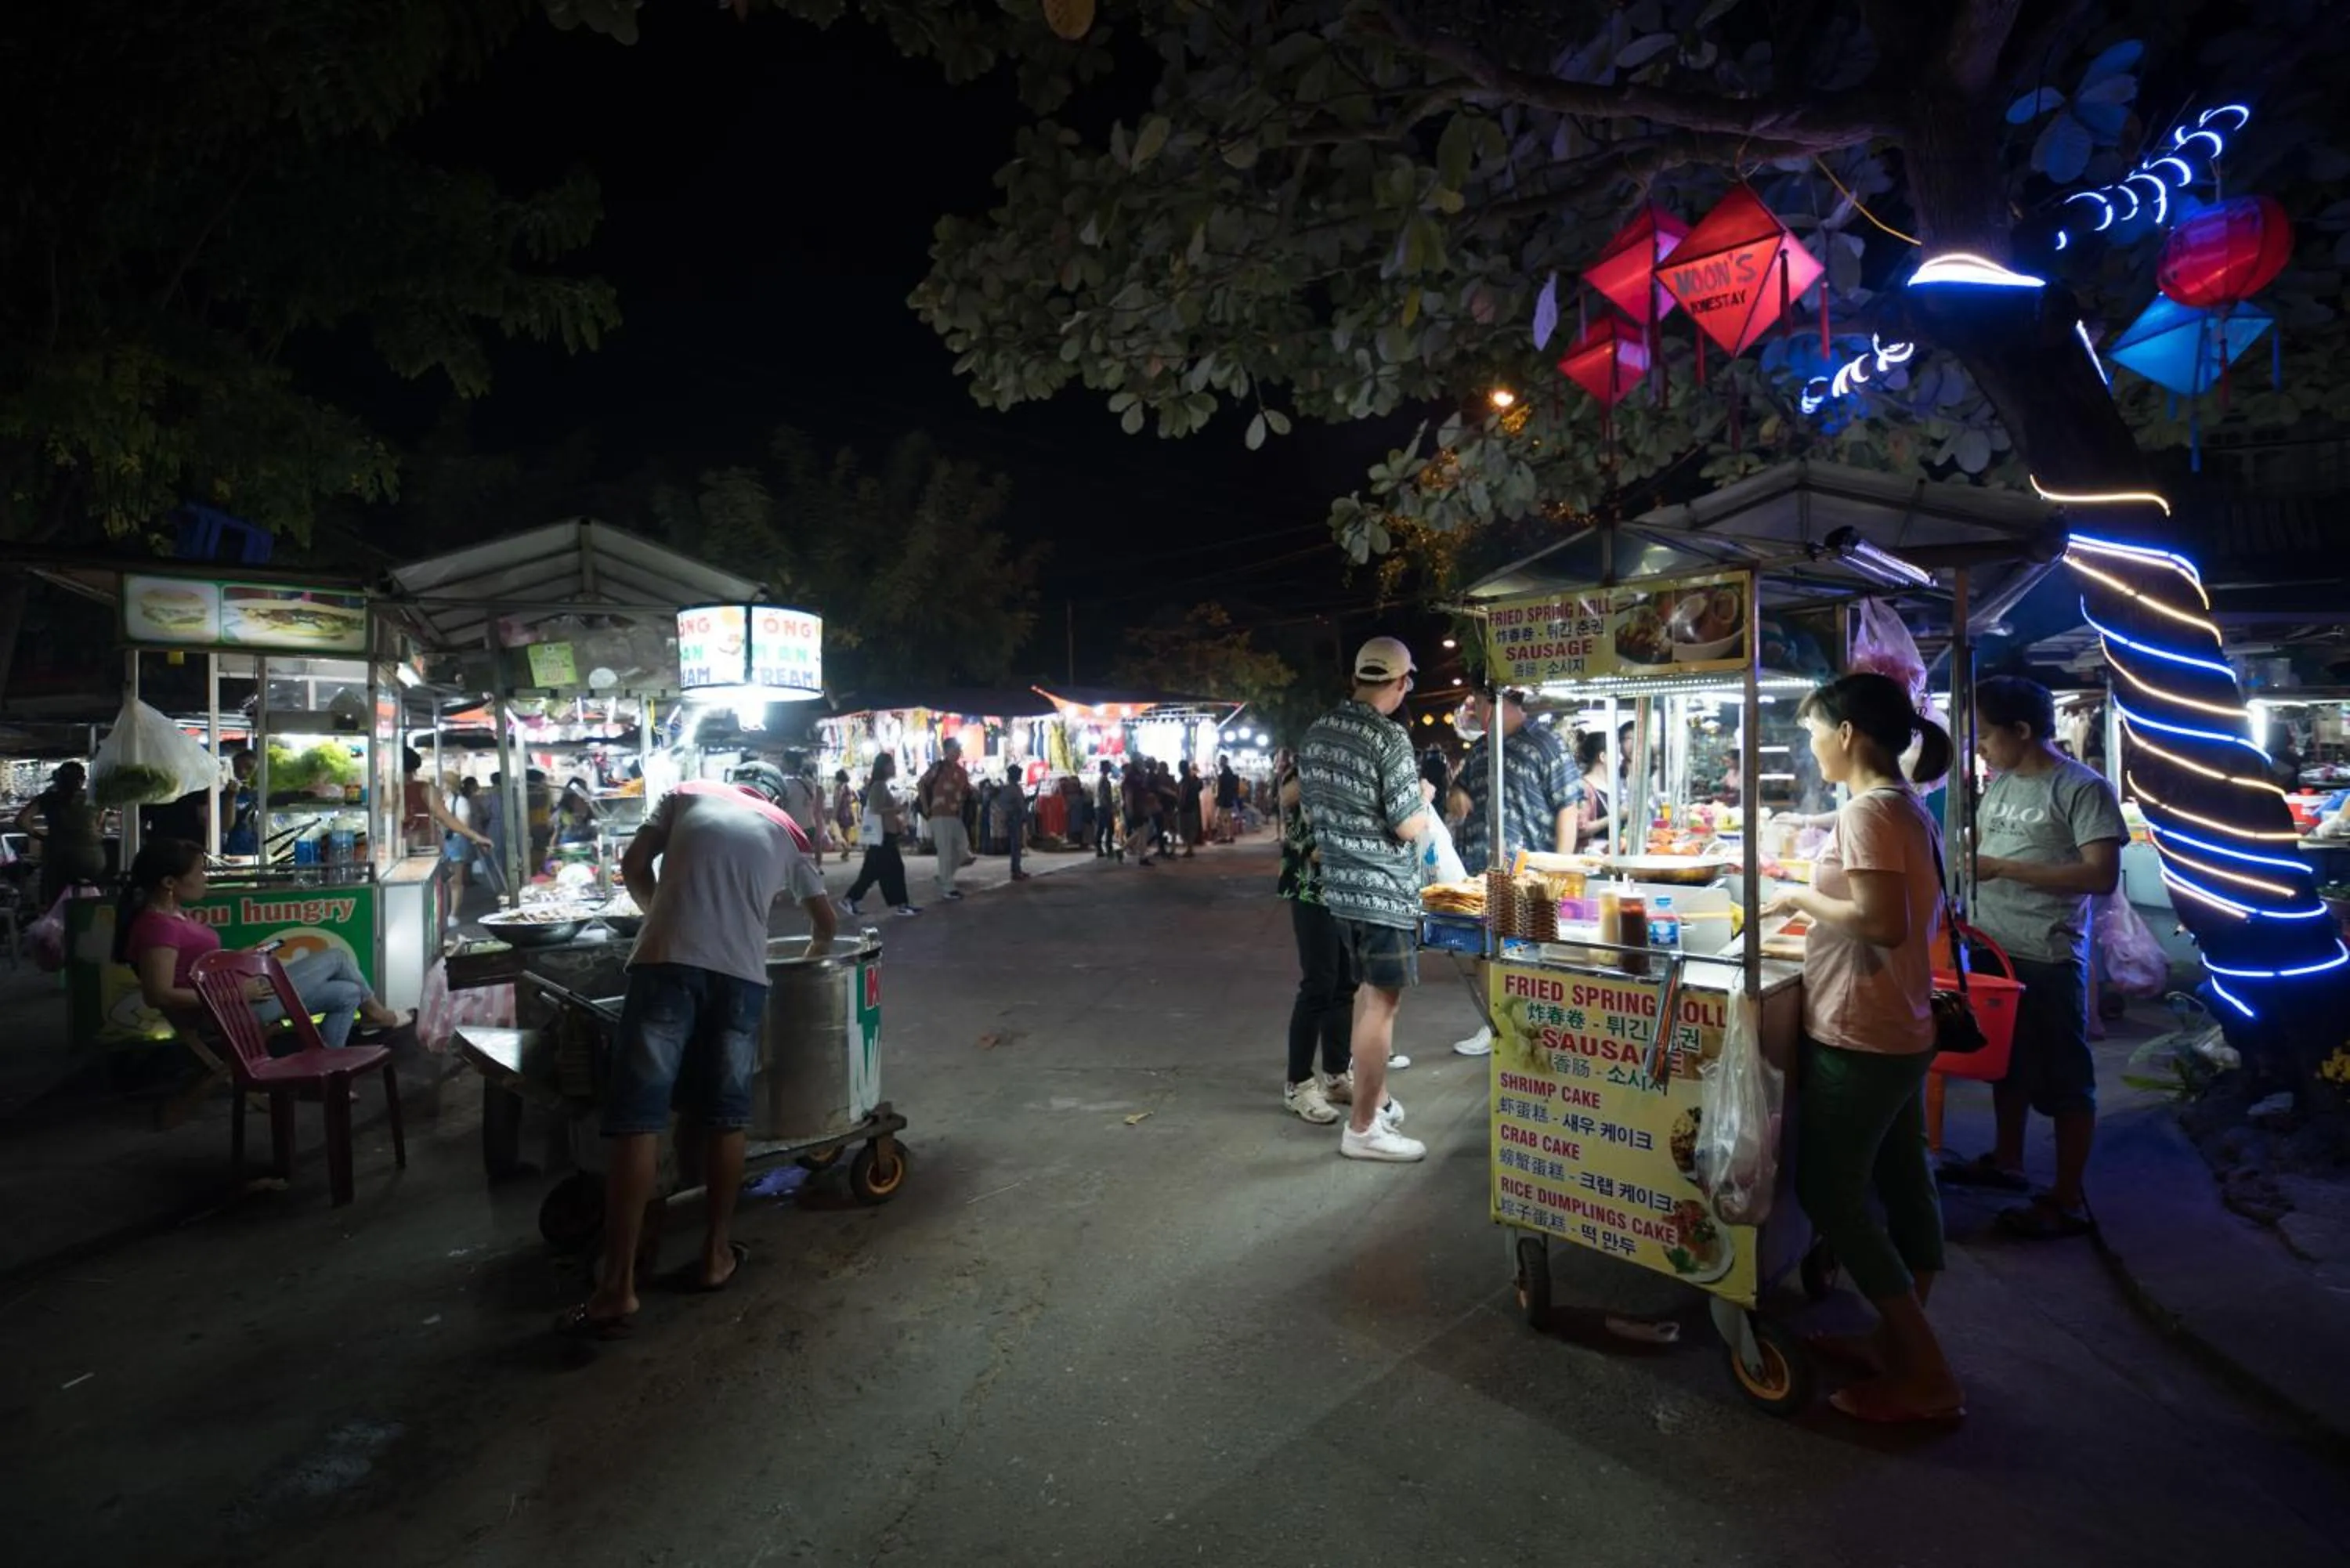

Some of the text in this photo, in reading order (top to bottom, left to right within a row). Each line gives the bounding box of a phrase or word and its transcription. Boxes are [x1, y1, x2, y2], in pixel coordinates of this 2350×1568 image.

[1488, 608, 1523, 627] FRIED
[1528, 602, 1574, 623] SPRING
[1506, 639, 1593, 662] SAUSAGE
[184, 897, 356, 927] ou hungry
[1505, 974, 1726, 1028] FRIED SPRING OLL
[1606, 1015, 1648, 1041] 튀긴
[1542, 1028, 1682, 1073] SAUSAE
[1553, 1054, 1590, 1078] 香肠
[1500, 1072, 1601, 1109] SHRIMP CAKE
[1500, 1124, 1580, 1161] CRAB CAKE
[1562, 1113, 1596, 1136] 새우
[1600, 1122, 1654, 1151] 케이크
[1501, 1176, 1676, 1245] RICE DUMPLINGS CAKE
[1579, 1172, 1614, 1197] 크랩
[1619, 1181, 1673, 1212] 케이크
[1581, 1223, 1597, 1245] 떡
[1602, 1231, 1636, 1256] 만두
